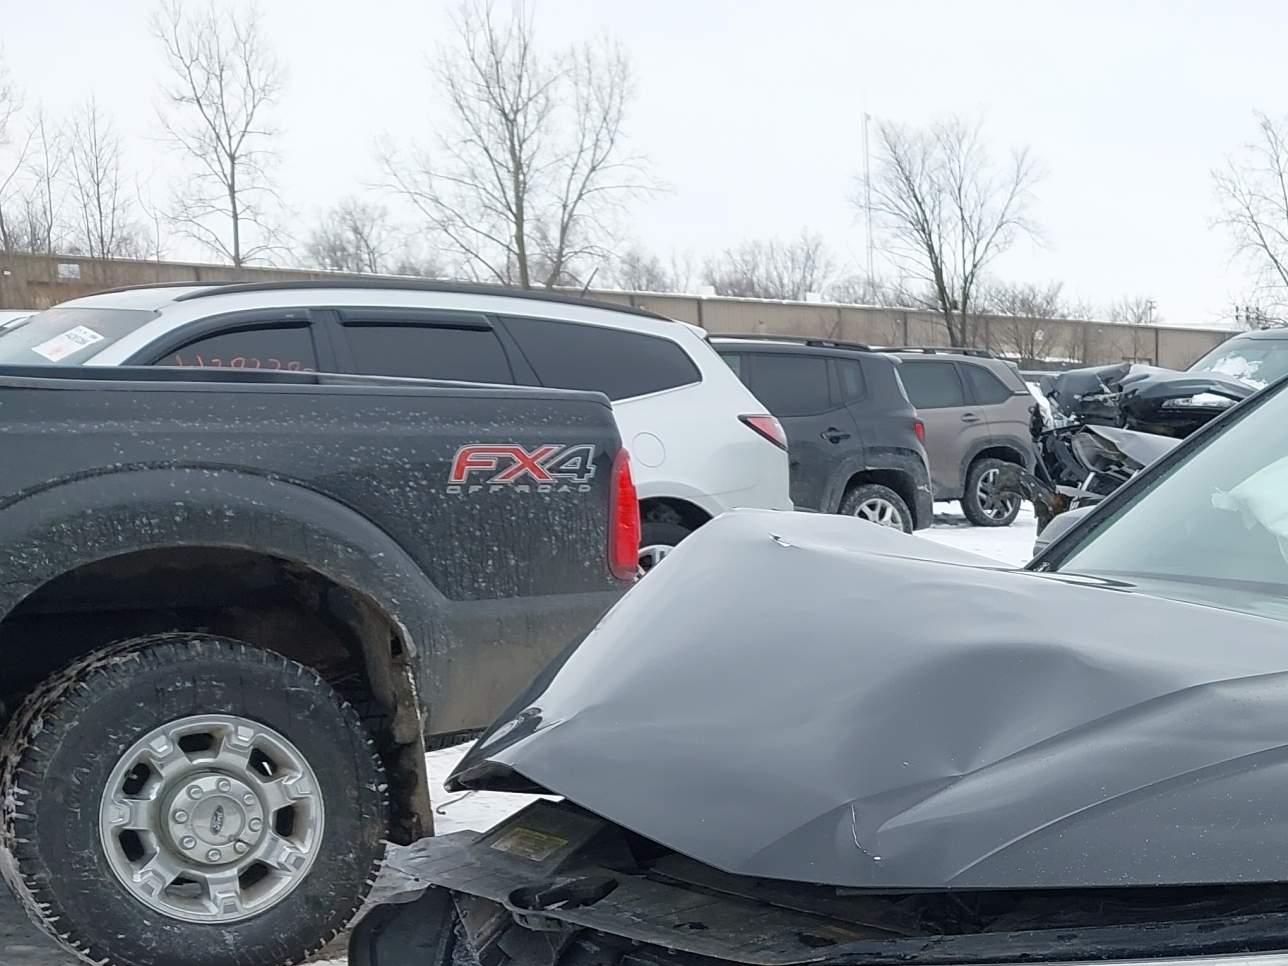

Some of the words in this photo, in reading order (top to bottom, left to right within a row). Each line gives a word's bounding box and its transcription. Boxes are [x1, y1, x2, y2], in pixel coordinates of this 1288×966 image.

[448, 443, 597, 484] FX4
[446, 484, 503, 494] OFF
[512, 484, 592, 494] ROAD
